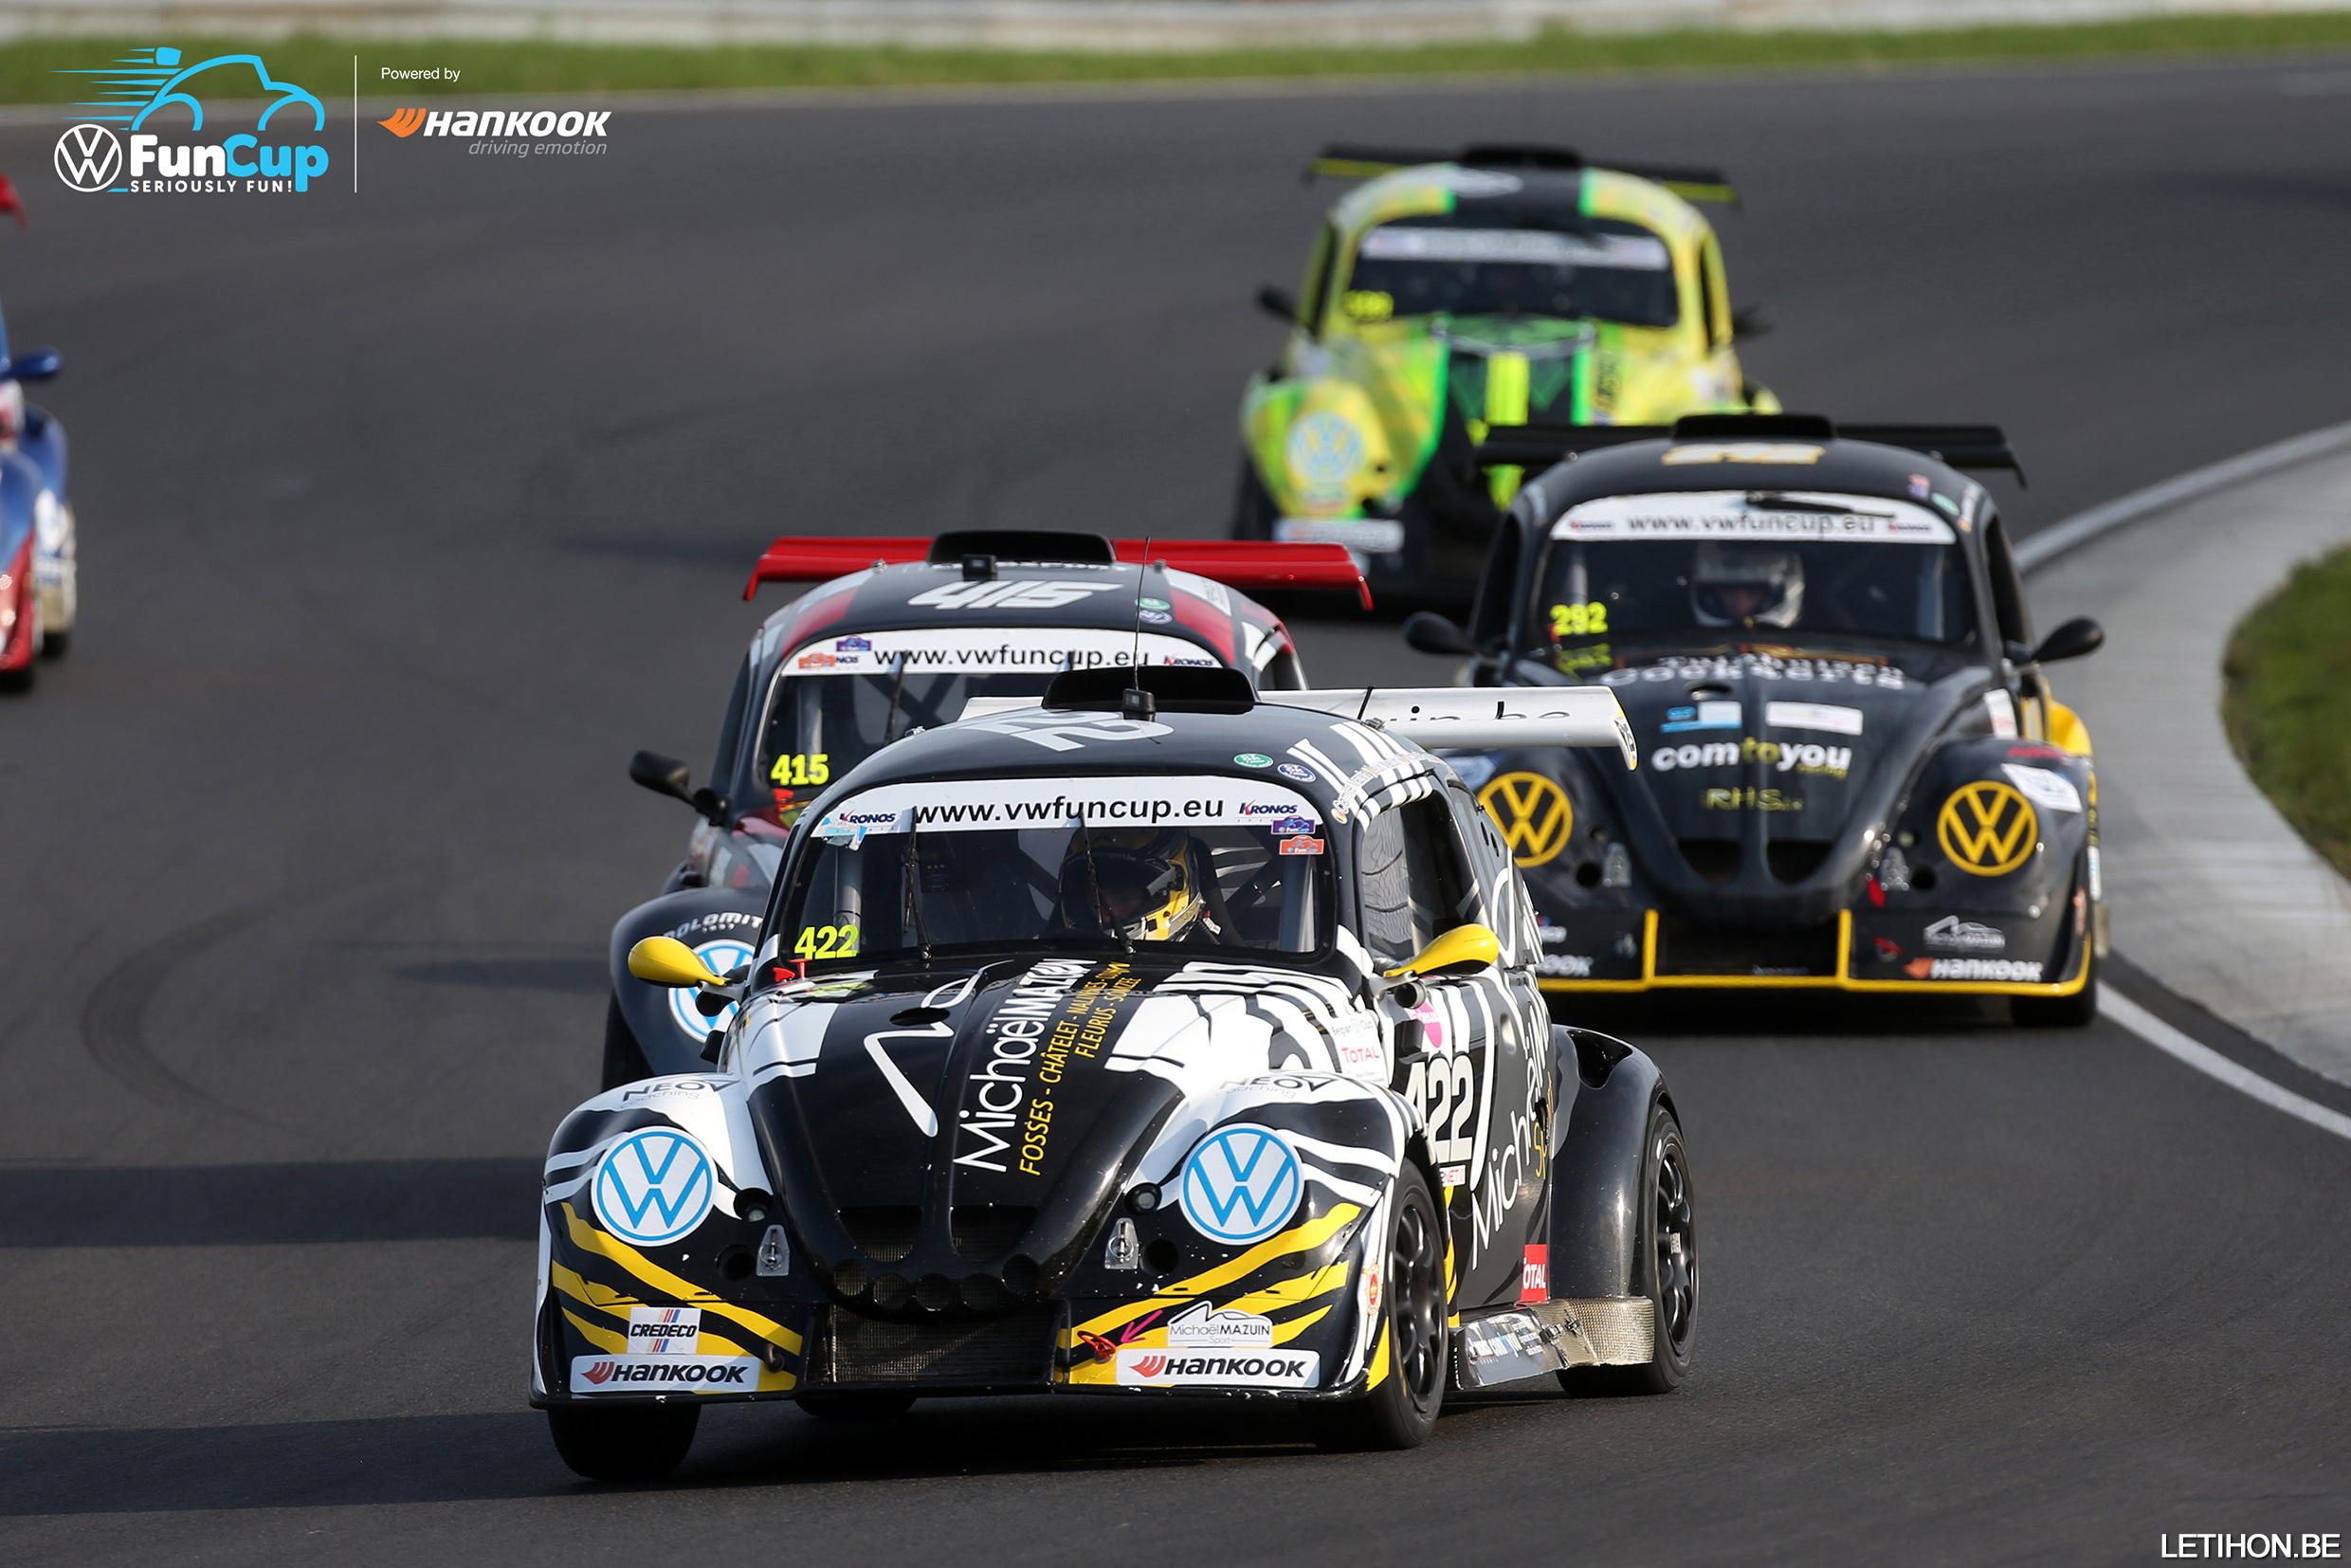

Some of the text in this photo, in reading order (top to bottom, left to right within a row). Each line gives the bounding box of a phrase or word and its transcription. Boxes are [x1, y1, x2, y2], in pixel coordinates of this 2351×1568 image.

[907, 579, 1125, 611] 415
[1550, 601, 1609, 636] 292
[874, 645, 1149, 670] www.vwfuncup.eu
[770, 754, 830, 786] 415
[839, 811, 897, 824] KRONOS
[913, 795, 1225, 824] www.vwfuncup.eu
[1239, 800, 1299, 815] KRONOS
[664, 912, 764, 939] DOLOMIT
[794, 925, 860, 959] 422
[1074, 1007, 1117, 1058] FLEURUS
[1020, 1098, 1054, 1176] FOSSES
[1039, 1019, 1080, 1085] CHÂTELET
[1405, 1055, 1474, 1163] 422
[1522, 1256, 1547, 1290] OTAL
[629, 1323, 698, 1338] CREDECO
[1210, 1336, 1230, 1344] Sport
